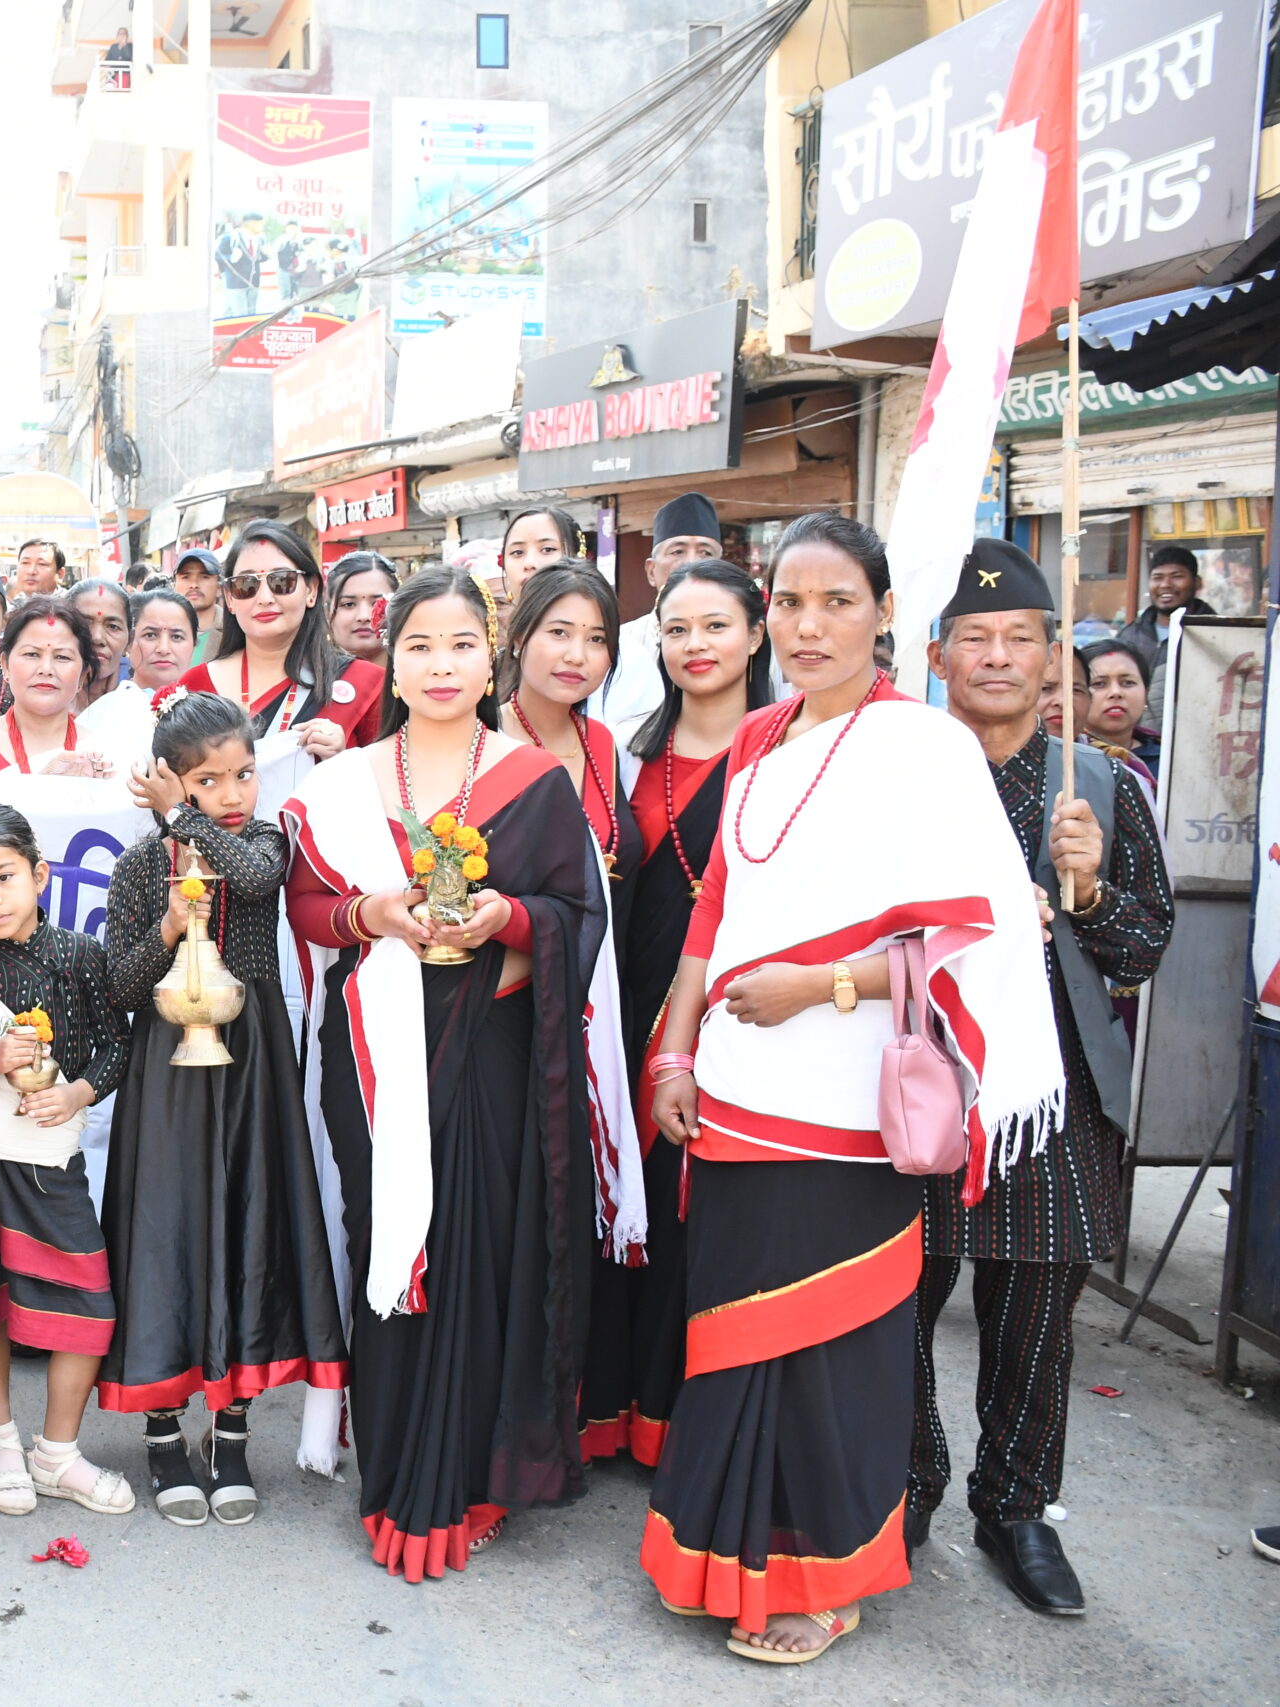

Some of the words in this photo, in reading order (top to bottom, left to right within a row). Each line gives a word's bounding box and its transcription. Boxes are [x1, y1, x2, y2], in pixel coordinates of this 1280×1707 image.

[264, 120, 325, 144] खुल्यो
[831, 61, 953, 215] सौर्य
[276, 200, 324, 217] कक्षा
[430, 285, 538, 300] STUDYSYS
[604, 371, 722, 440] BOUTIQUE
